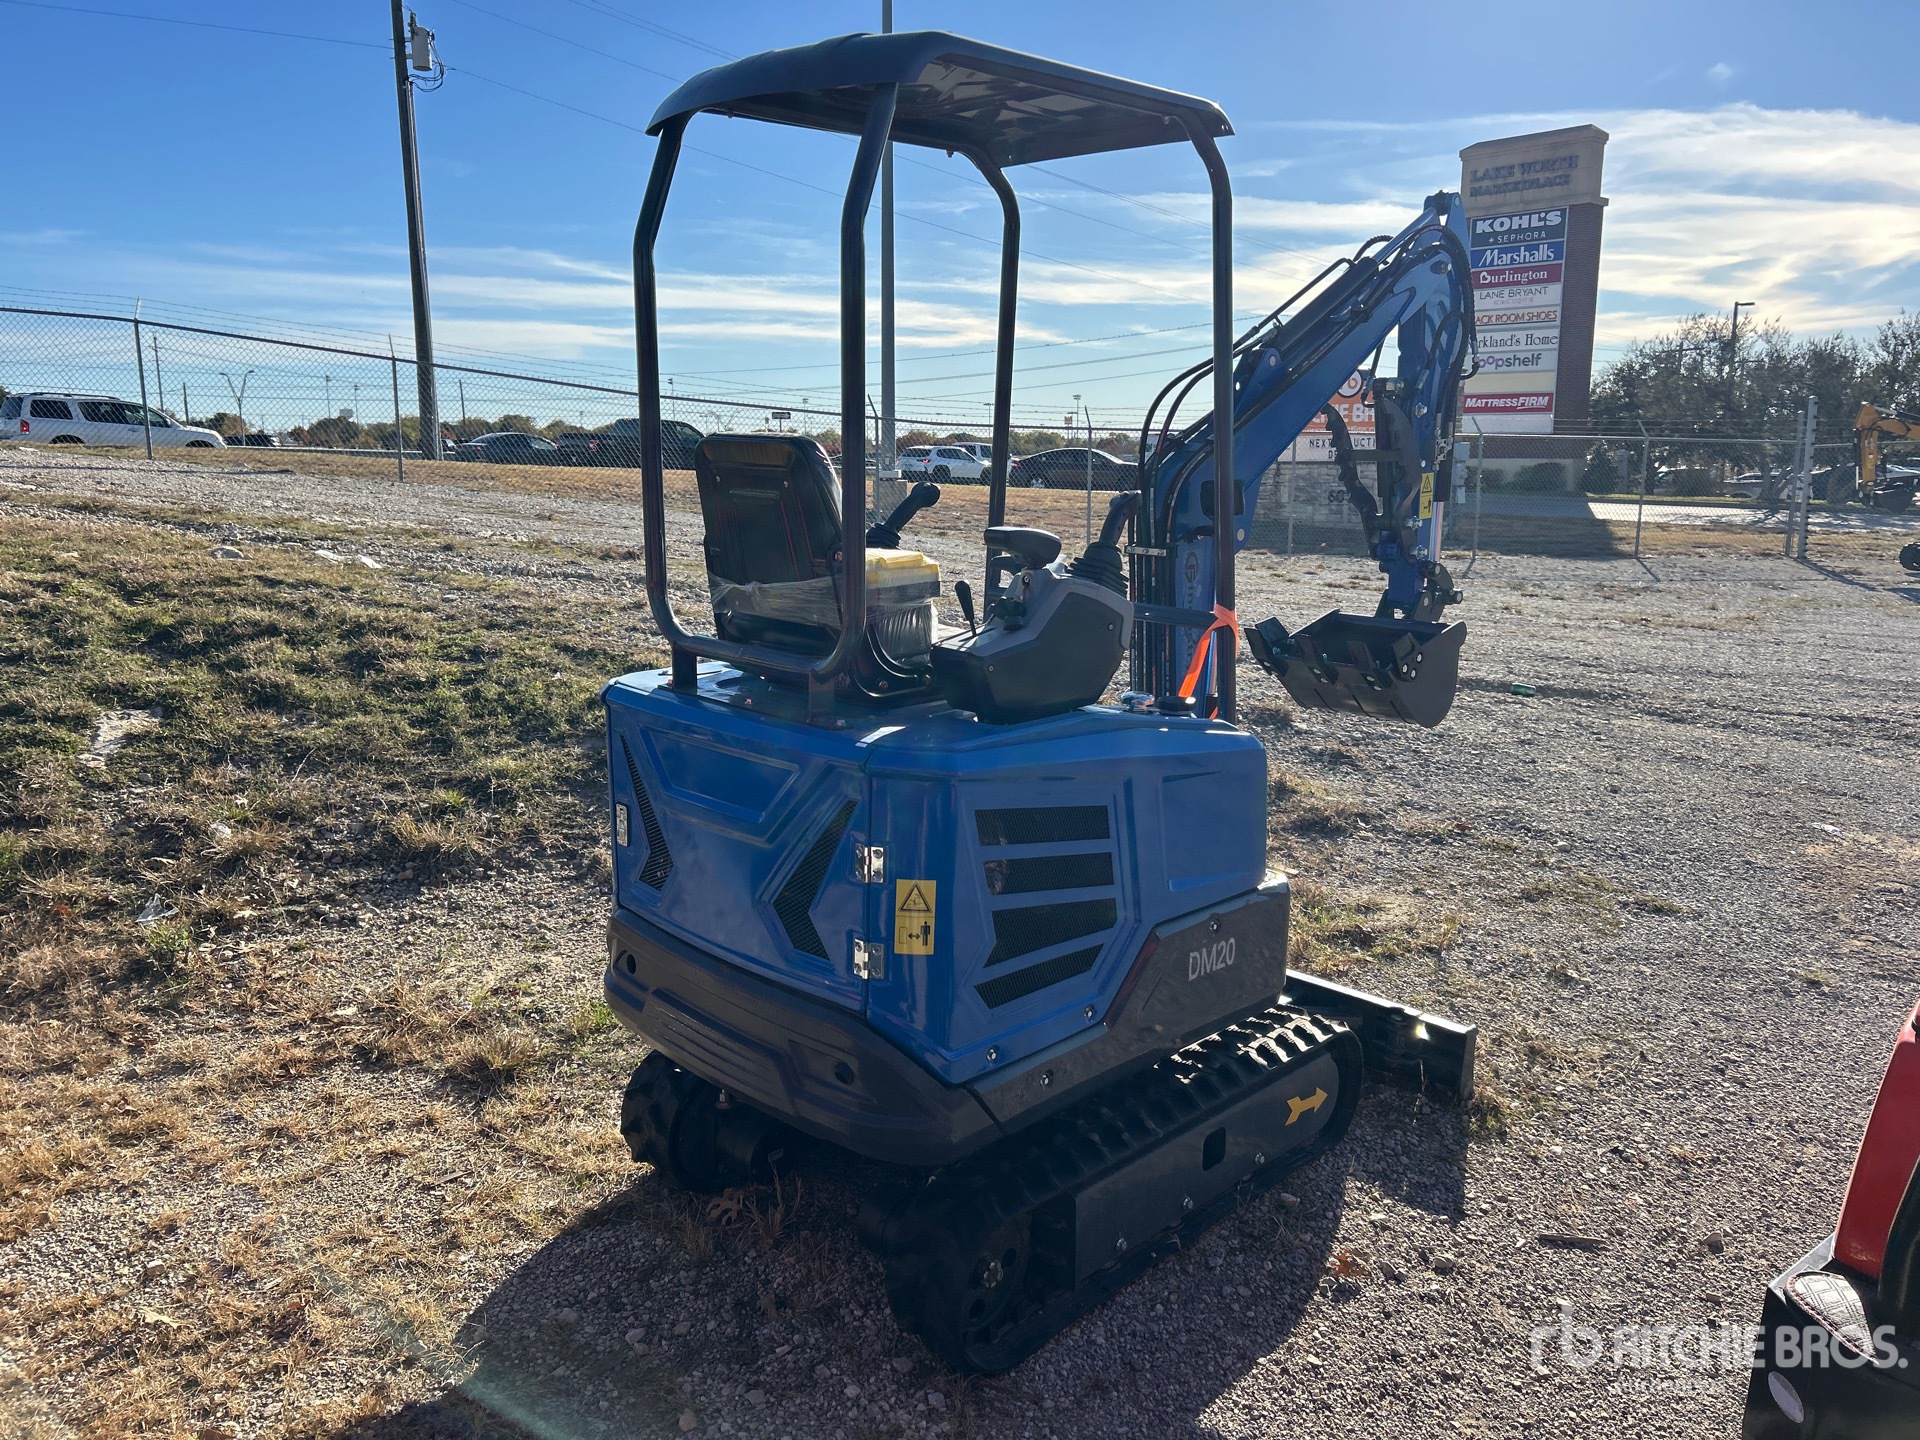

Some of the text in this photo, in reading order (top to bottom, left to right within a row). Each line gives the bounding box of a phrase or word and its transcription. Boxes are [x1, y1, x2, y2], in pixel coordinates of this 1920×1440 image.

[1470, 155, 1579, 183] LAKE WORTH
[1476, 211, 1562, 233] KOHL'S
[1497, 231, 1546, 243] SEPHORA
[1478, 244, 1555, 267] Marshalls
[1480, 270, 1548, 284] Burlington
[1479, 286, 1549, 300] LANE BRYANT
[1475, 310, 1558, 325] ACK ROOM SHOES
[1478, 333, 1559, 348] rkland's Home
[1188, 937, 1236, 981] DM20
